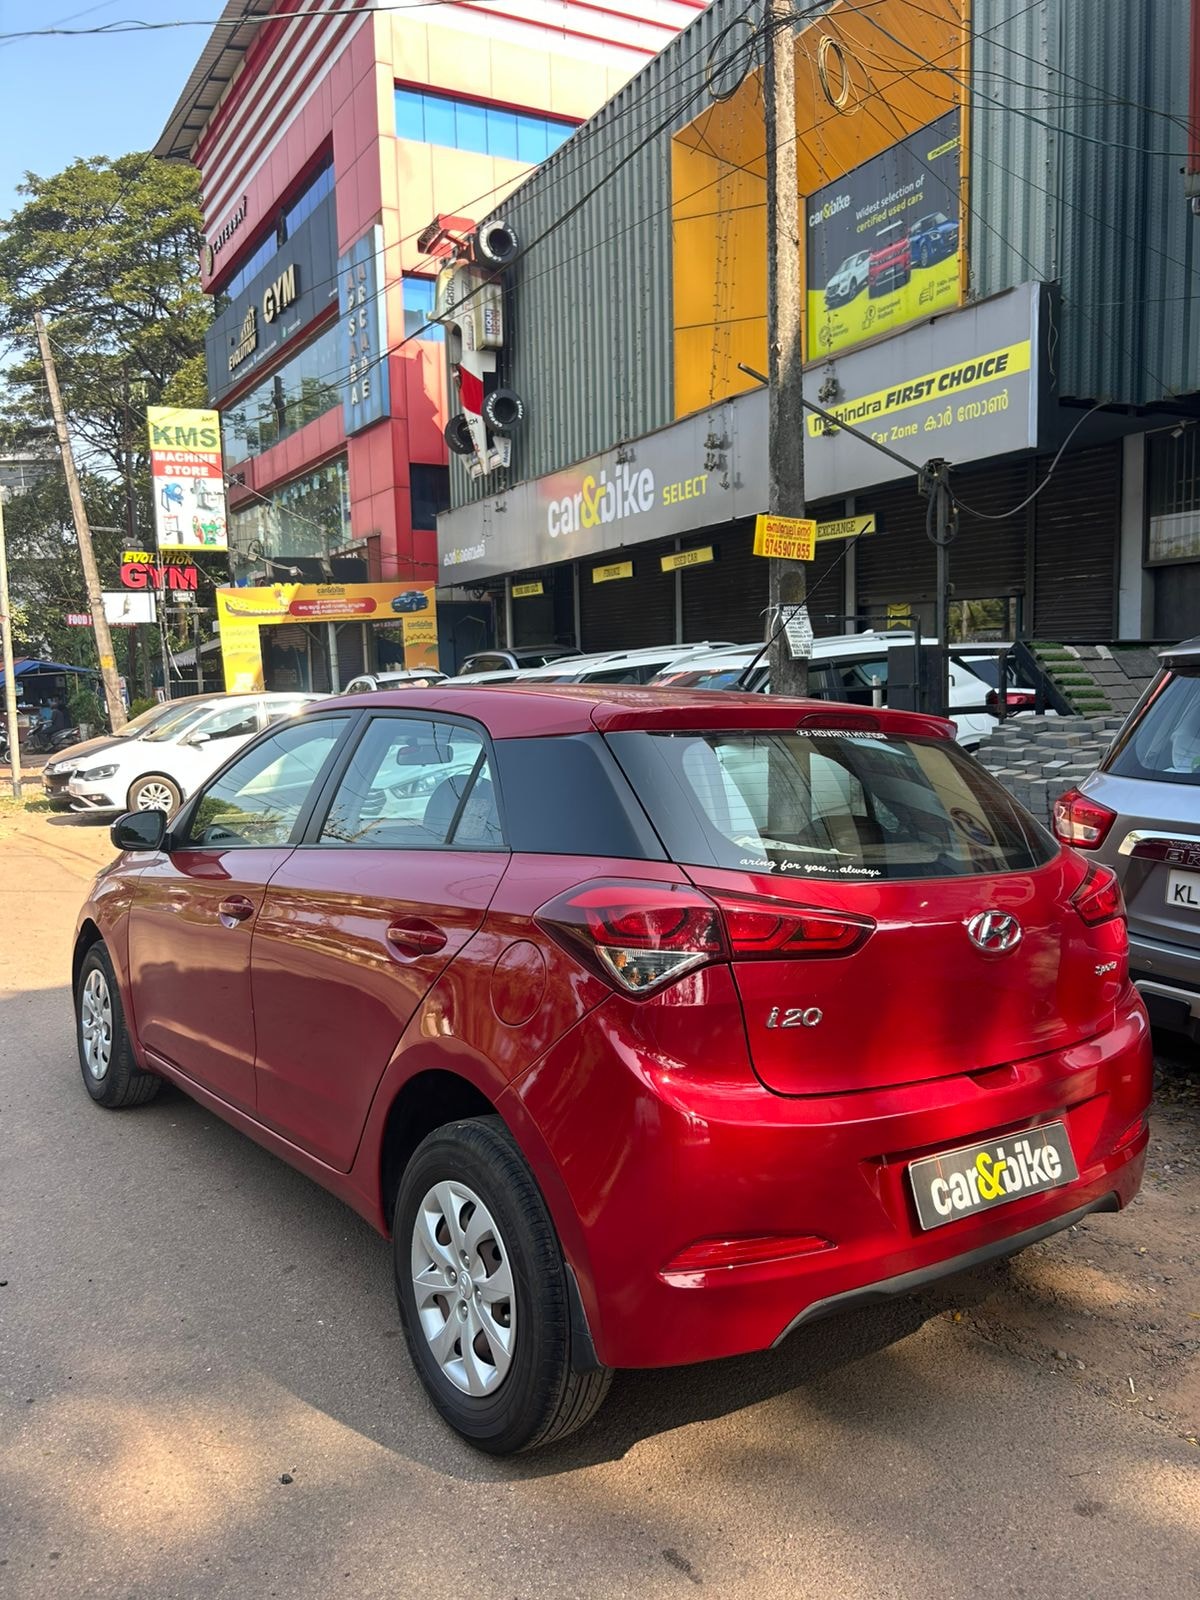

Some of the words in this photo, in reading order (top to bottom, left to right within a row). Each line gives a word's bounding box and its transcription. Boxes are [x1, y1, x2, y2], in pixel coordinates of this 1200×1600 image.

[856, 200, 880, 220] Widest
[881, 183, 914, 207] selection
[915, 174, 925, 188] of
[808, 194, 851, 227] car&bike
[856, 209, 887, 233] certified
[888, 198, 906, 217] used
[907, 192, 924, 206] cars
[264, 264, 296, 323] GYM
[885, 378, 936, 409] FIRST
[938, 353, 1009, 391] CHOICE
[924, 405, 953, 432] കാർ
[152, 425, 218, 448] KMS
[891, 422, 919, 441] Zone
[154, 451, 217, 464] MACHINE
[164, 465, 209, 477] STORE
[547, 462, 655, 538] car&bike
[662, 474, 709, 506] SELECT
[817, 520, 856, 538] EXCHANGE
[687, 552, 699, 564] CAR
[121, 562, 198, 590] GYM
[68, 613, 88, 625] FOOD
[780, 859, 801, 871] for
[1174, 883, 1199, 905] KL
[766, 1006, 823, 1028] i20
[930, 1140, 1062, 1216] car&bike
